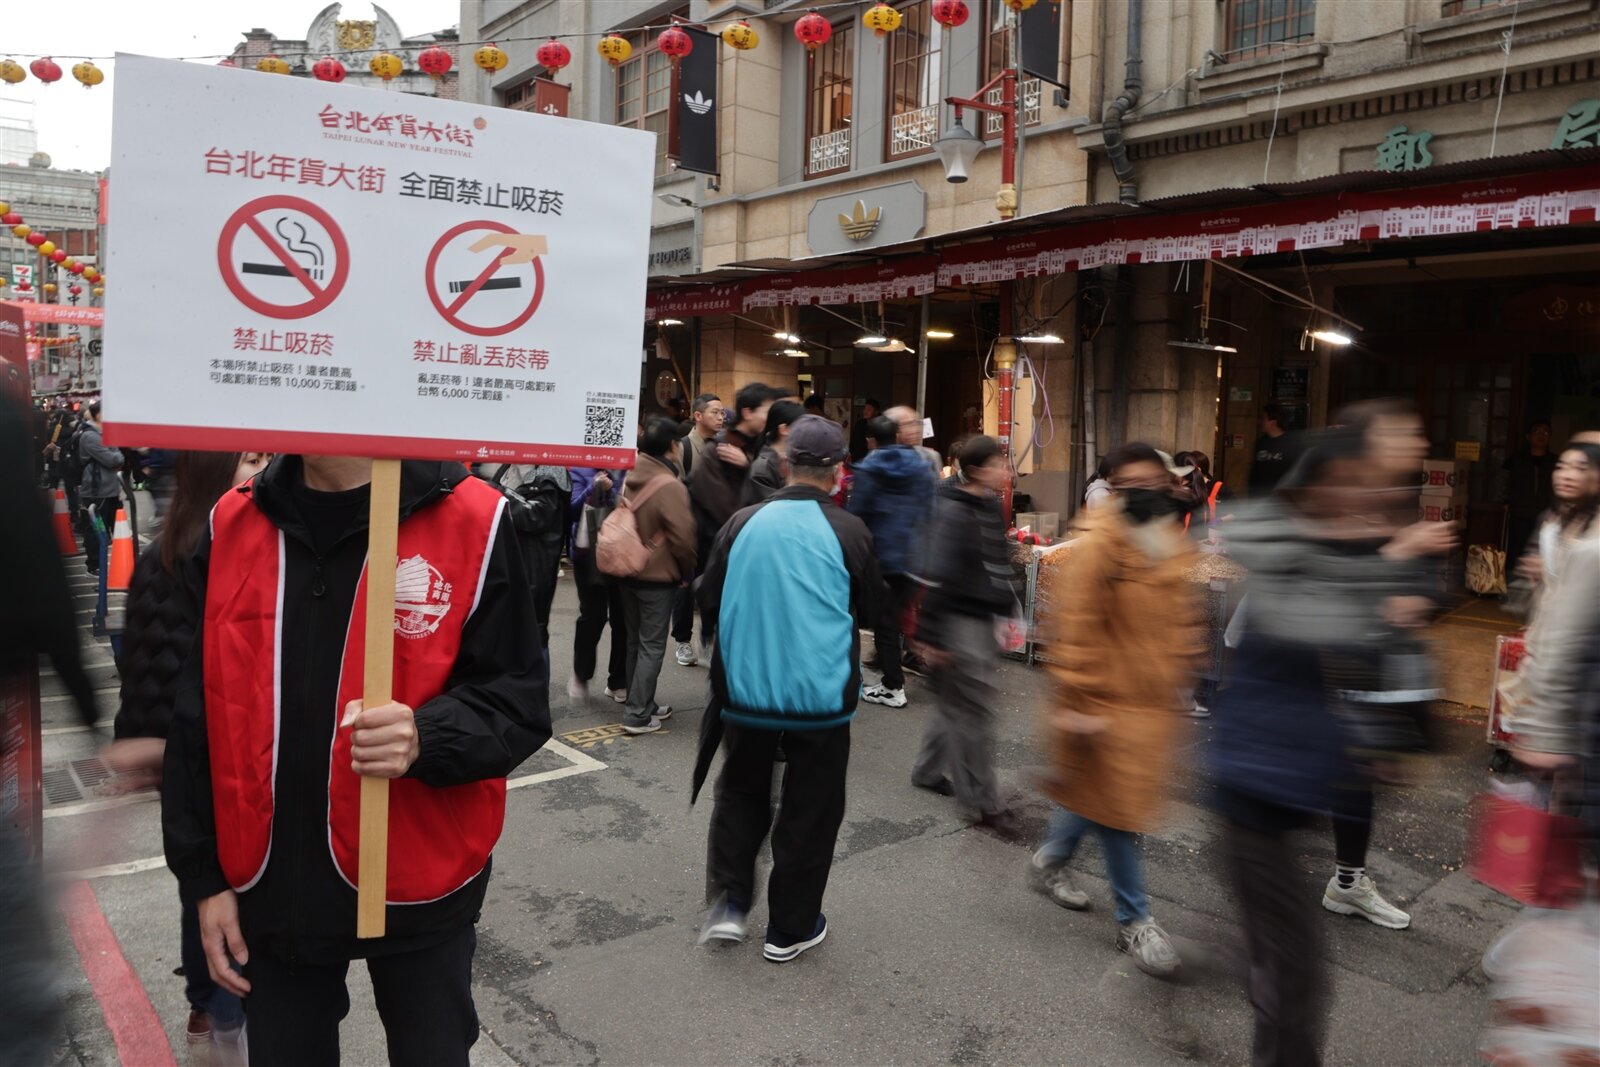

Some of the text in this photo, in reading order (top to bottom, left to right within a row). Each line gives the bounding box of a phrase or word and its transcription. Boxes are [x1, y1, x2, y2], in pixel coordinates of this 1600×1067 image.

[318, 103, 475, 148] 台北年貨大街
[322, 131, 473, 159] TAIPEI LUNAR NEW YEAR FESTIVAL
[204, 146, 564, 216] 台北年貨大街 全面禁止吸菸
[656, 247, 691, 264] HOUSE
[233, 326, 335, 356] 禁止吸菸
[413, 339, 550, 371] 禁止亂丟菸蒂
[285, 376, 321, 389] 10,000
[417, 385, 439, 397] 台幣
[441, 387, 469, 399] 6,000
[433, 579, 452, 593] 迪化
